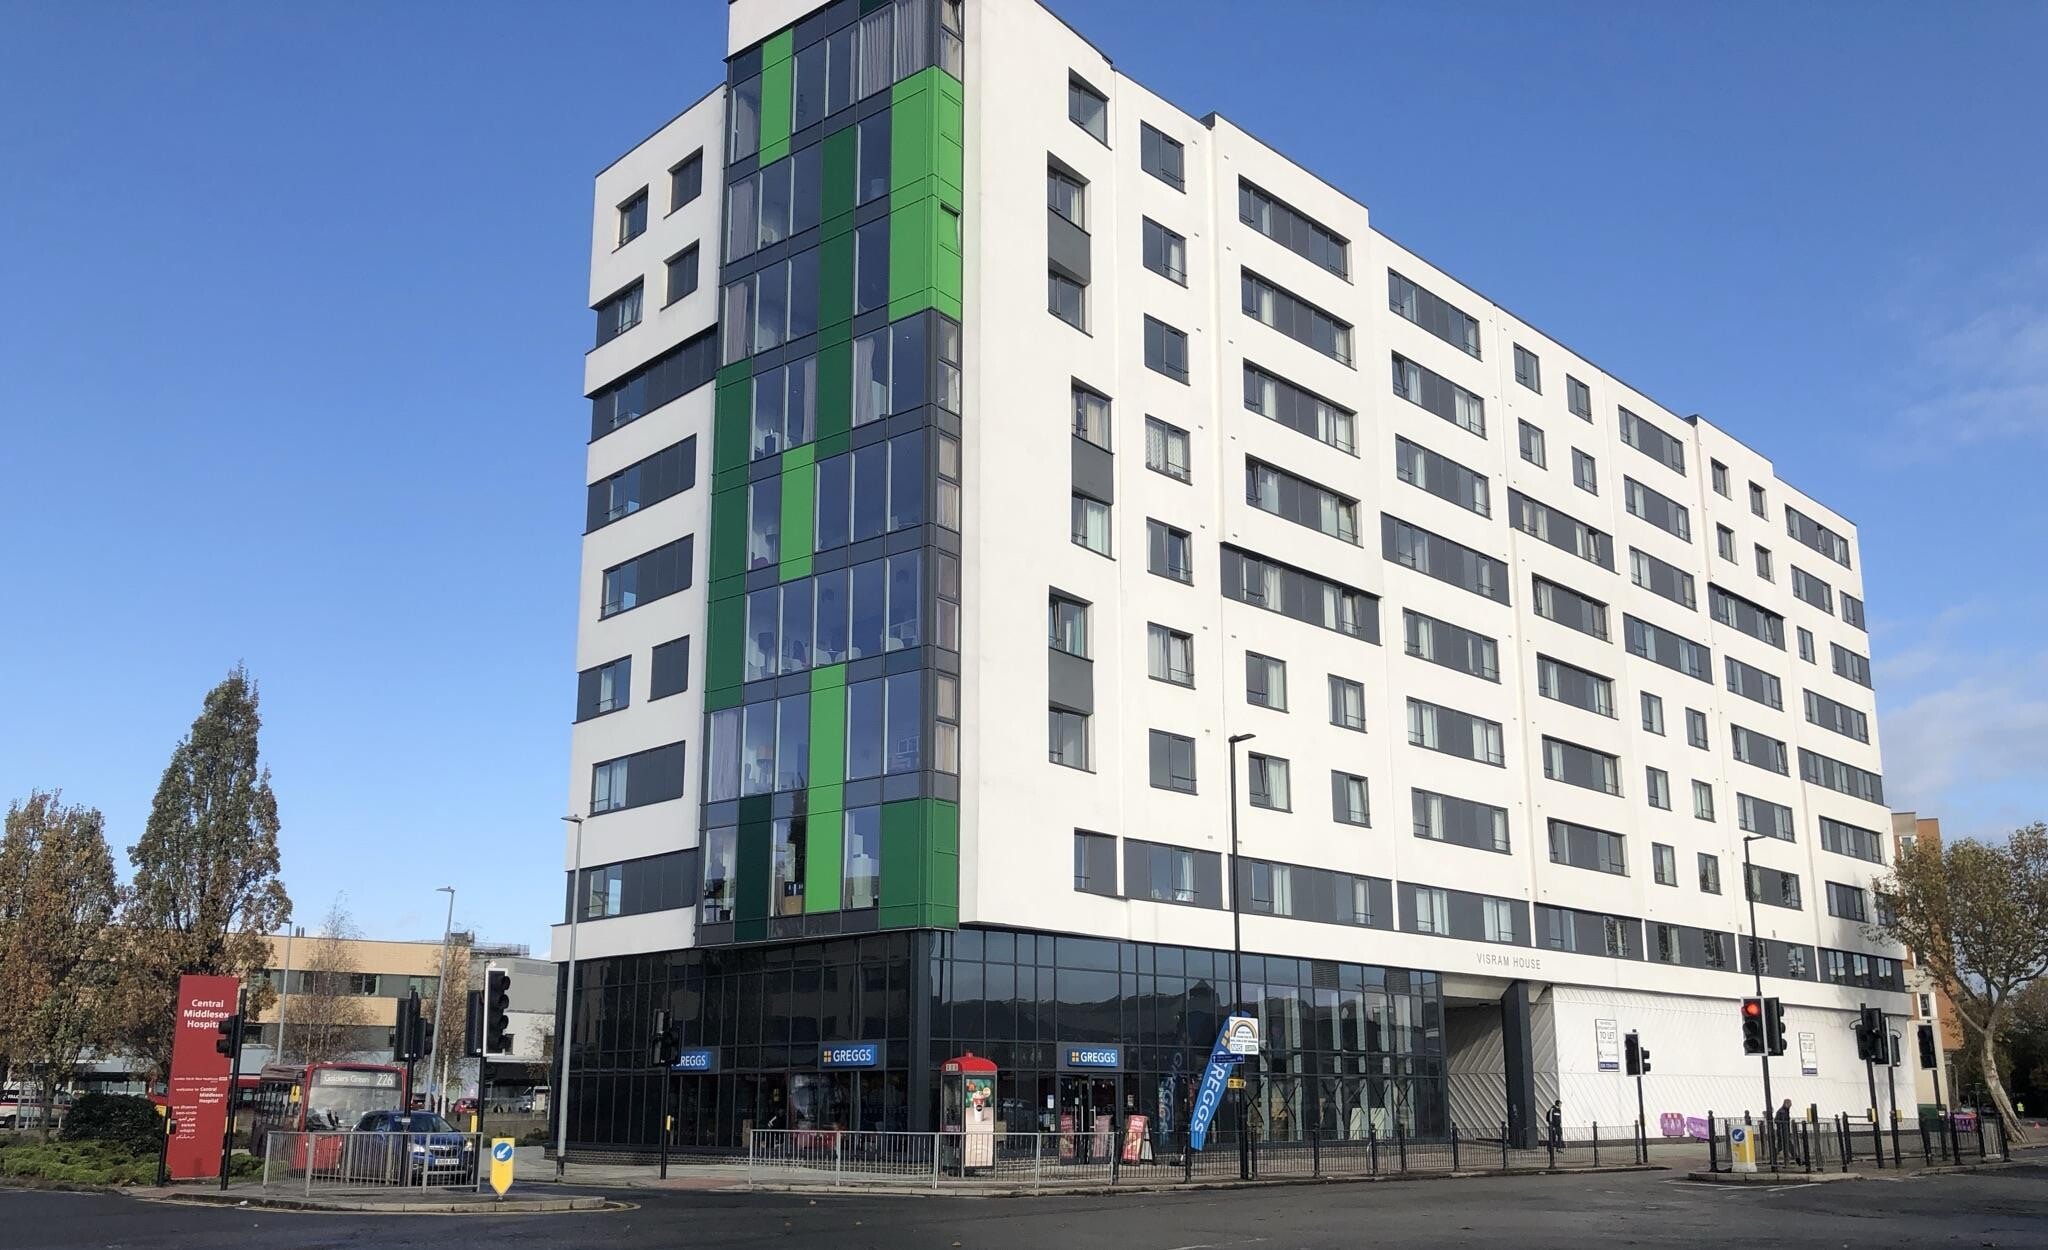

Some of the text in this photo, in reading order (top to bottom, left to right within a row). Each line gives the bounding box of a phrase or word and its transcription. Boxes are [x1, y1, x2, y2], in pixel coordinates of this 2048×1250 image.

[1476, 952, 1541, 970] VISRAM HOUSE
[191, 999, 224, 1008] Central
[183, 1009, 230, 1018] Middlesex
[186, 1020, 220, 1030] Hospita
[675, 1055, 706, 1067] REGGS
[832, 1048, 872, 1062] GREGGS
[1080, 1051, 1116, 1063] GREGGS
[350, 1075, 370, 1083] Green
[376, 1073, 393, 1086] 226
